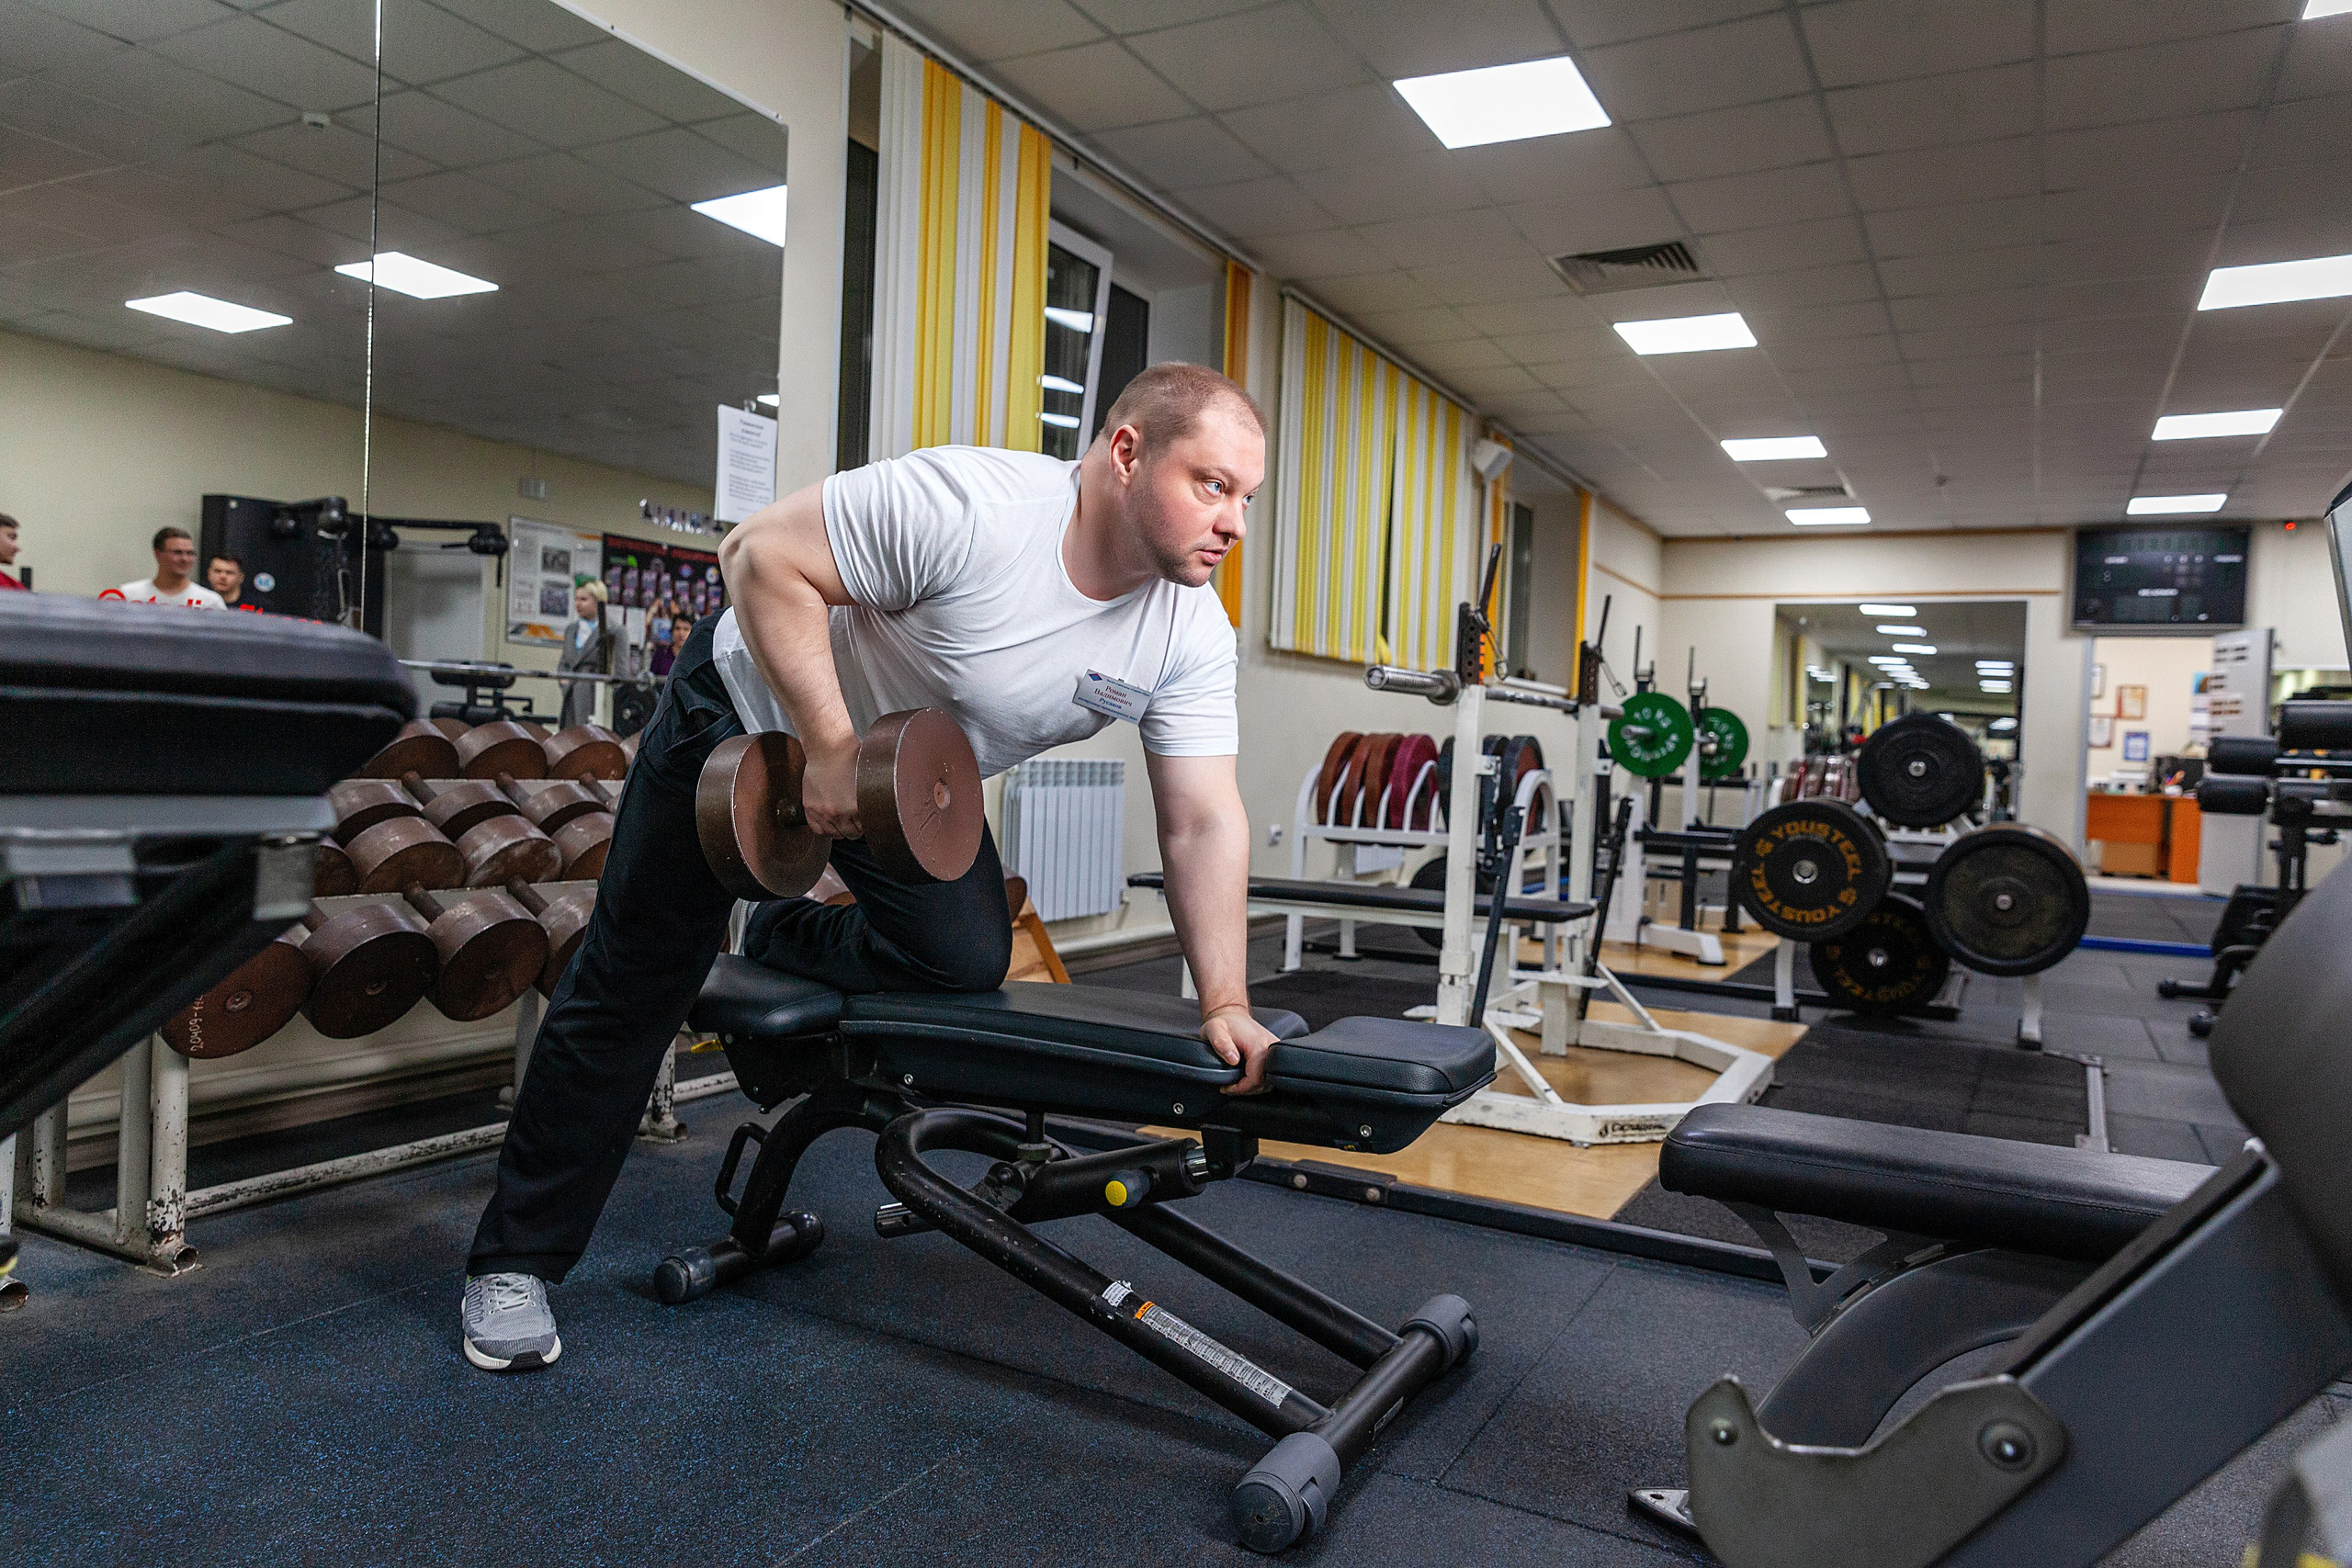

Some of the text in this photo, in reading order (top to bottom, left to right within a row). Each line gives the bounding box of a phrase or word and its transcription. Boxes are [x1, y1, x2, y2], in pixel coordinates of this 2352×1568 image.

[1093, 688, 1133, 707] Вадимович
[1105, 685, 1127, 698] Роман
[1770, 819, 1863, 882] YOUSTEEL
[1751, 862, 1843, 923] YOUSTEEL
